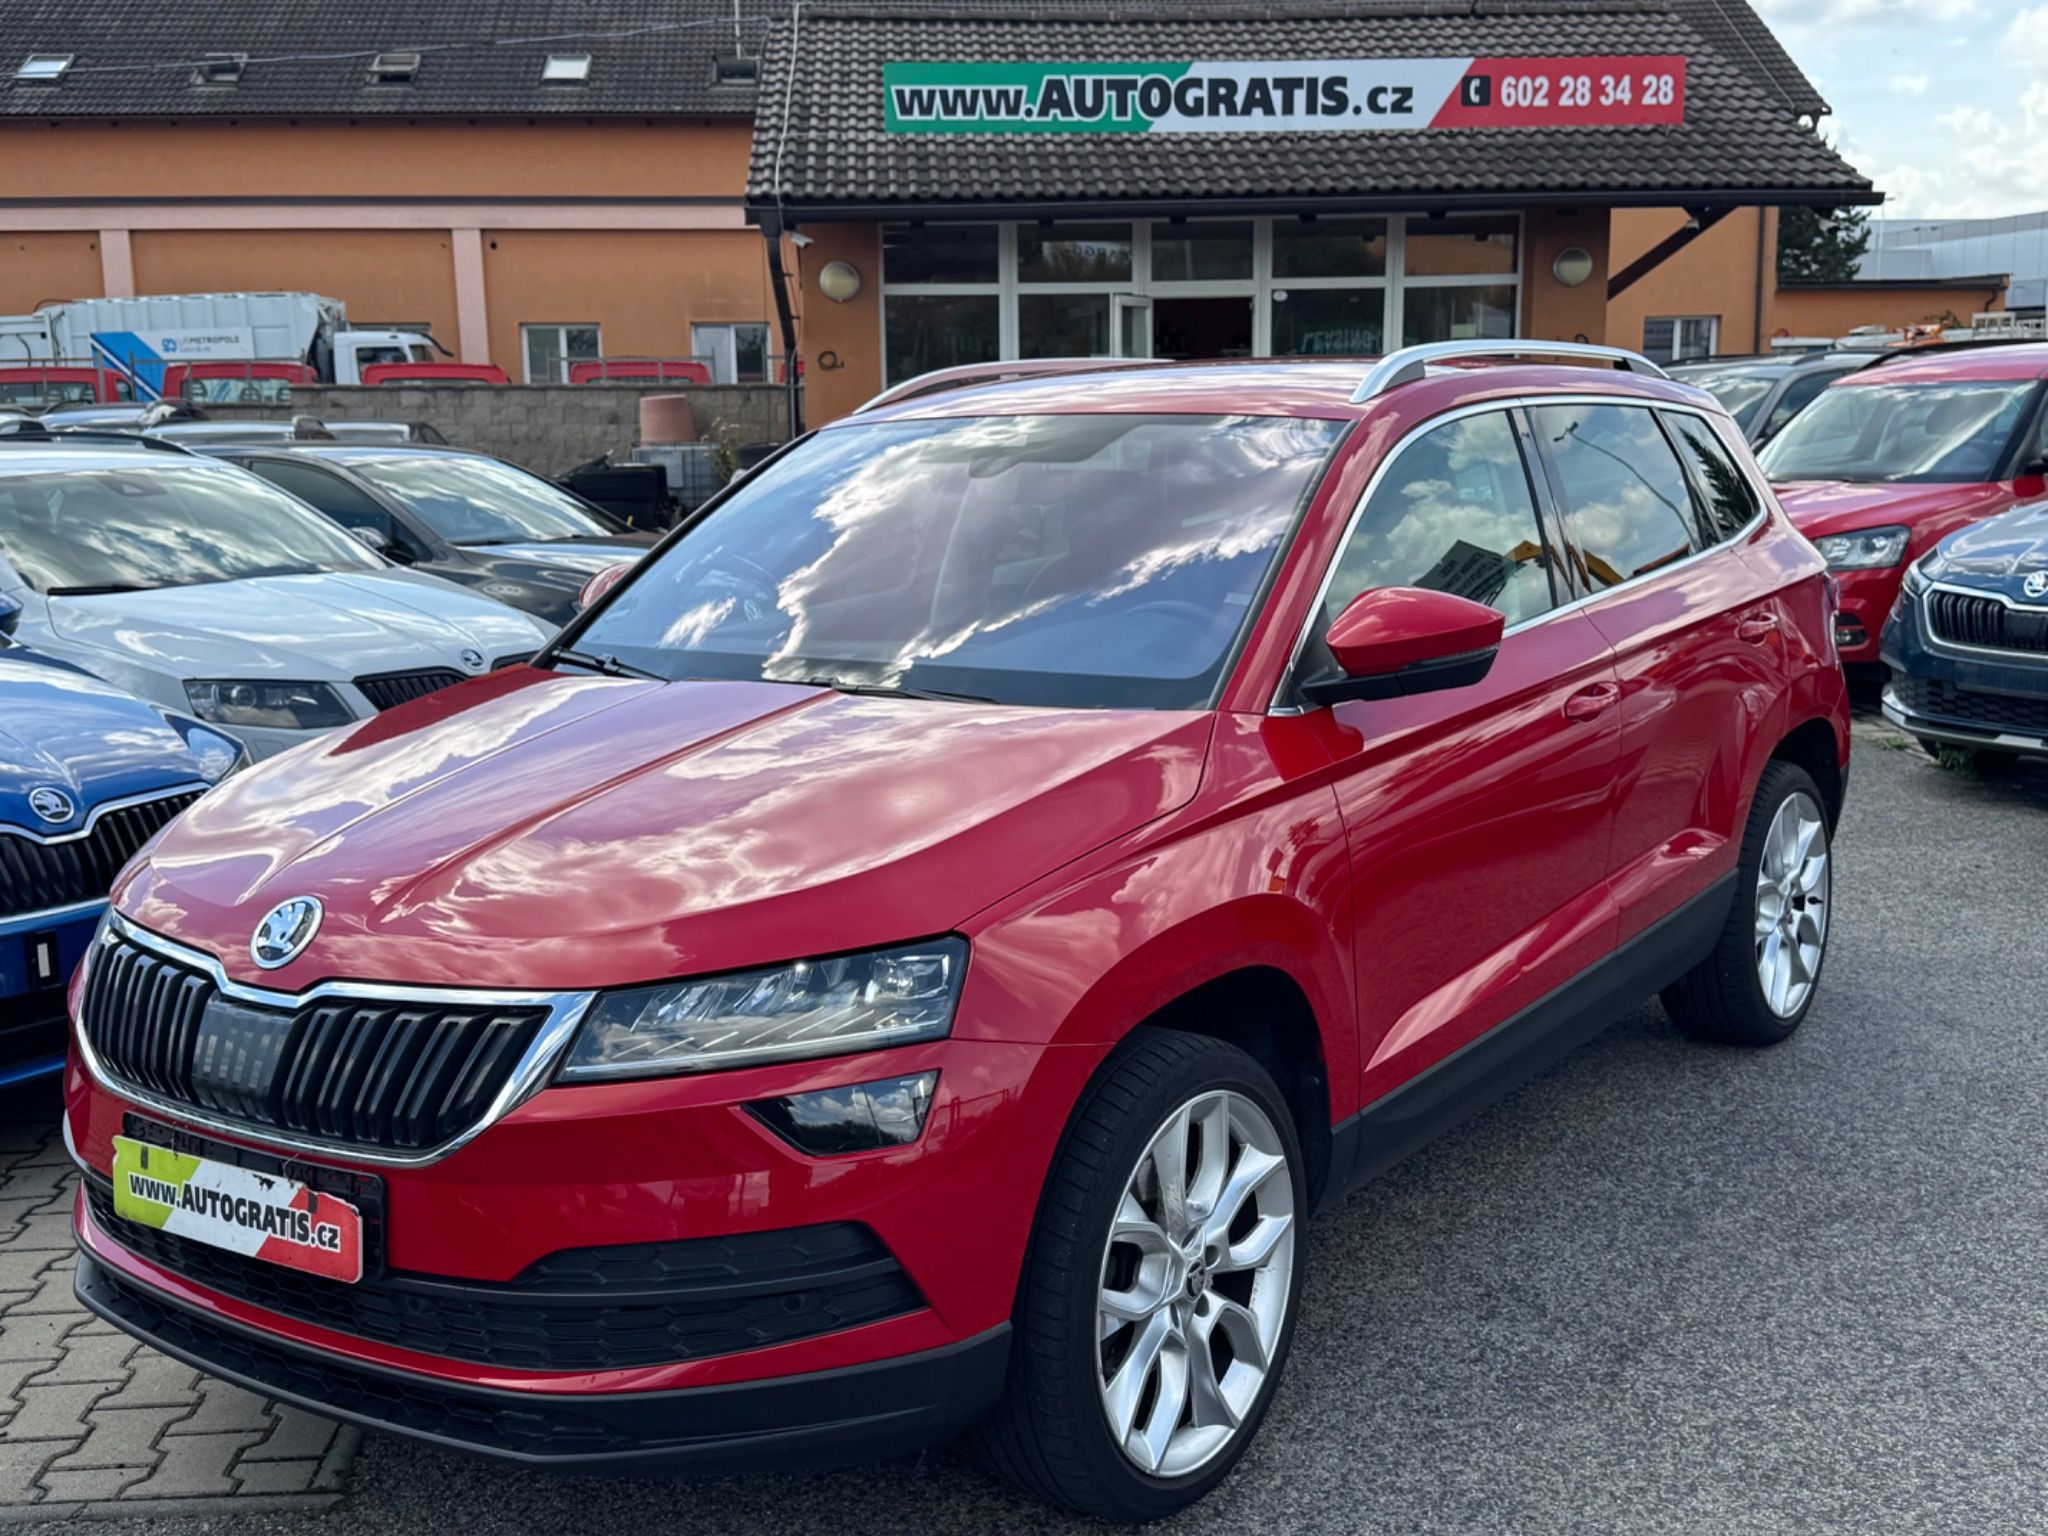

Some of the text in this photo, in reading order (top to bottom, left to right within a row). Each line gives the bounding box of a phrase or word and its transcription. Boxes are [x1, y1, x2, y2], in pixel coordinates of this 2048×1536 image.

[893, 73, 1675, 119] www.AUTOGRATIS.cz 602 28 34 28
